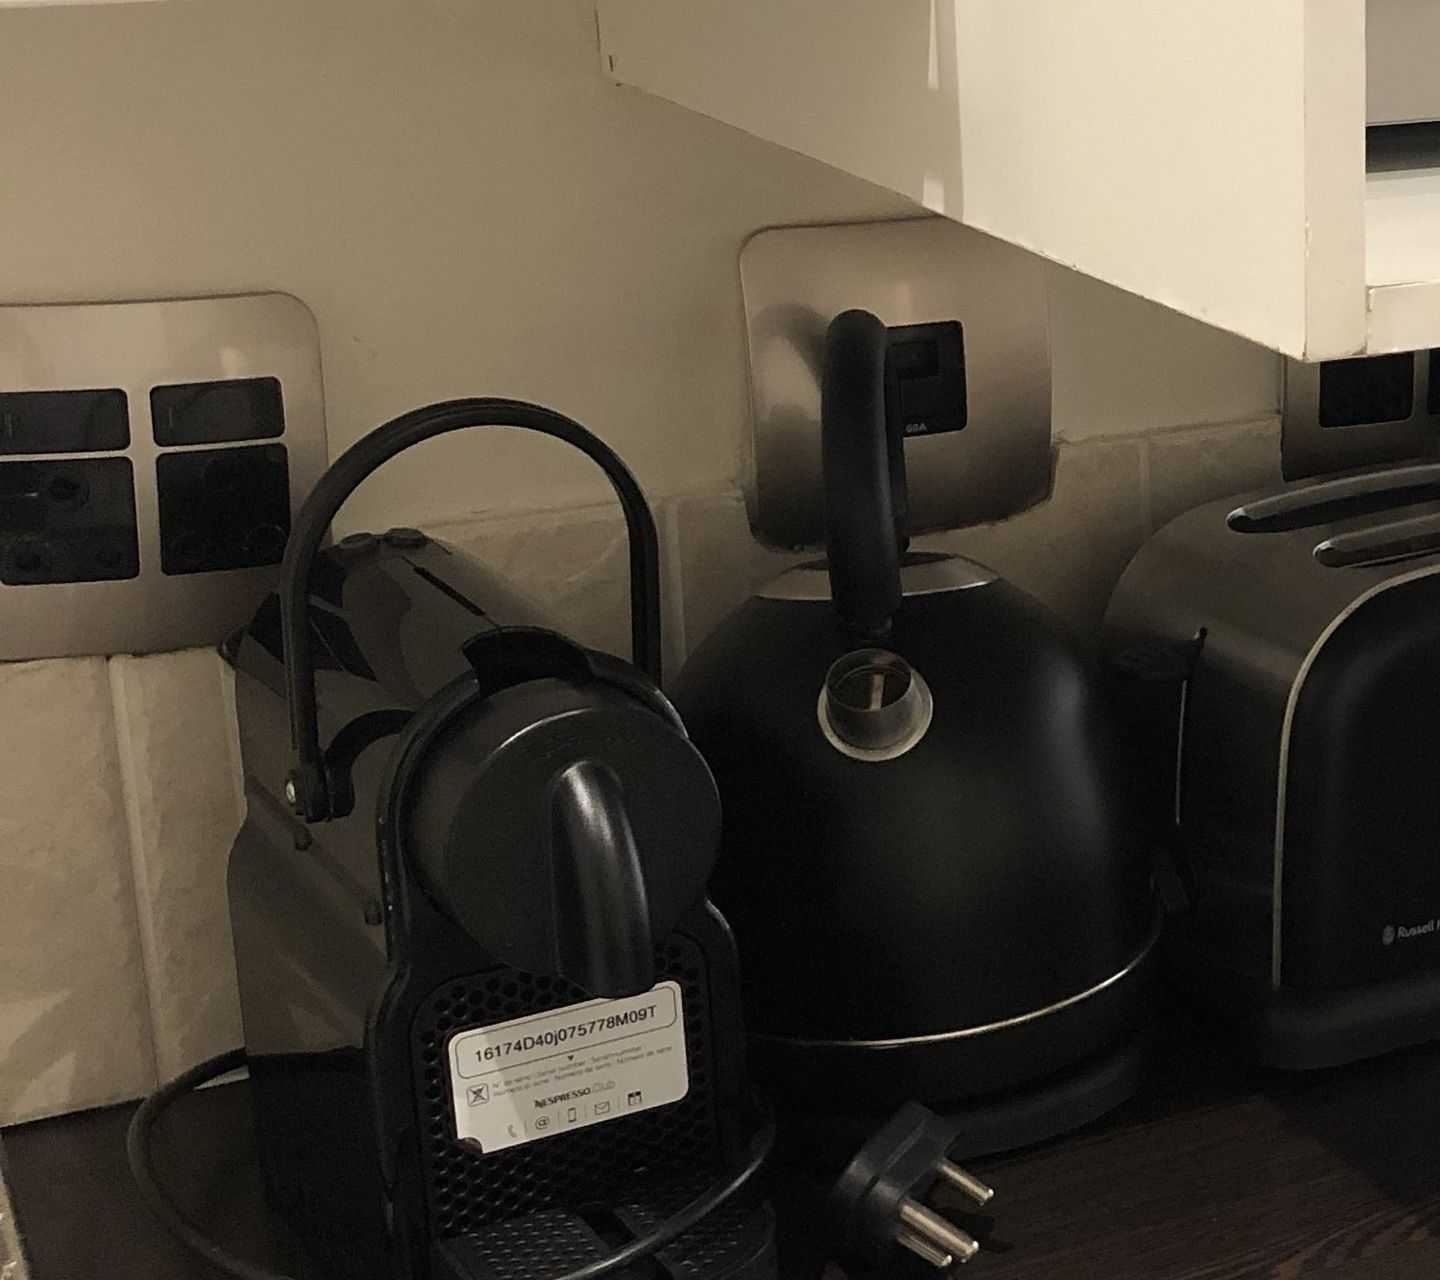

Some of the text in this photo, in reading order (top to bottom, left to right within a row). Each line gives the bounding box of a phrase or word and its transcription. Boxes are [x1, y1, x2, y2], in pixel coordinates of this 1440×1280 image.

[1397, 920, 1435, 938] Russell
[474, 1005, 658, 1063] 16174D40j075778M09T
[533, 1087, 591, 1109] NESPRESSO
